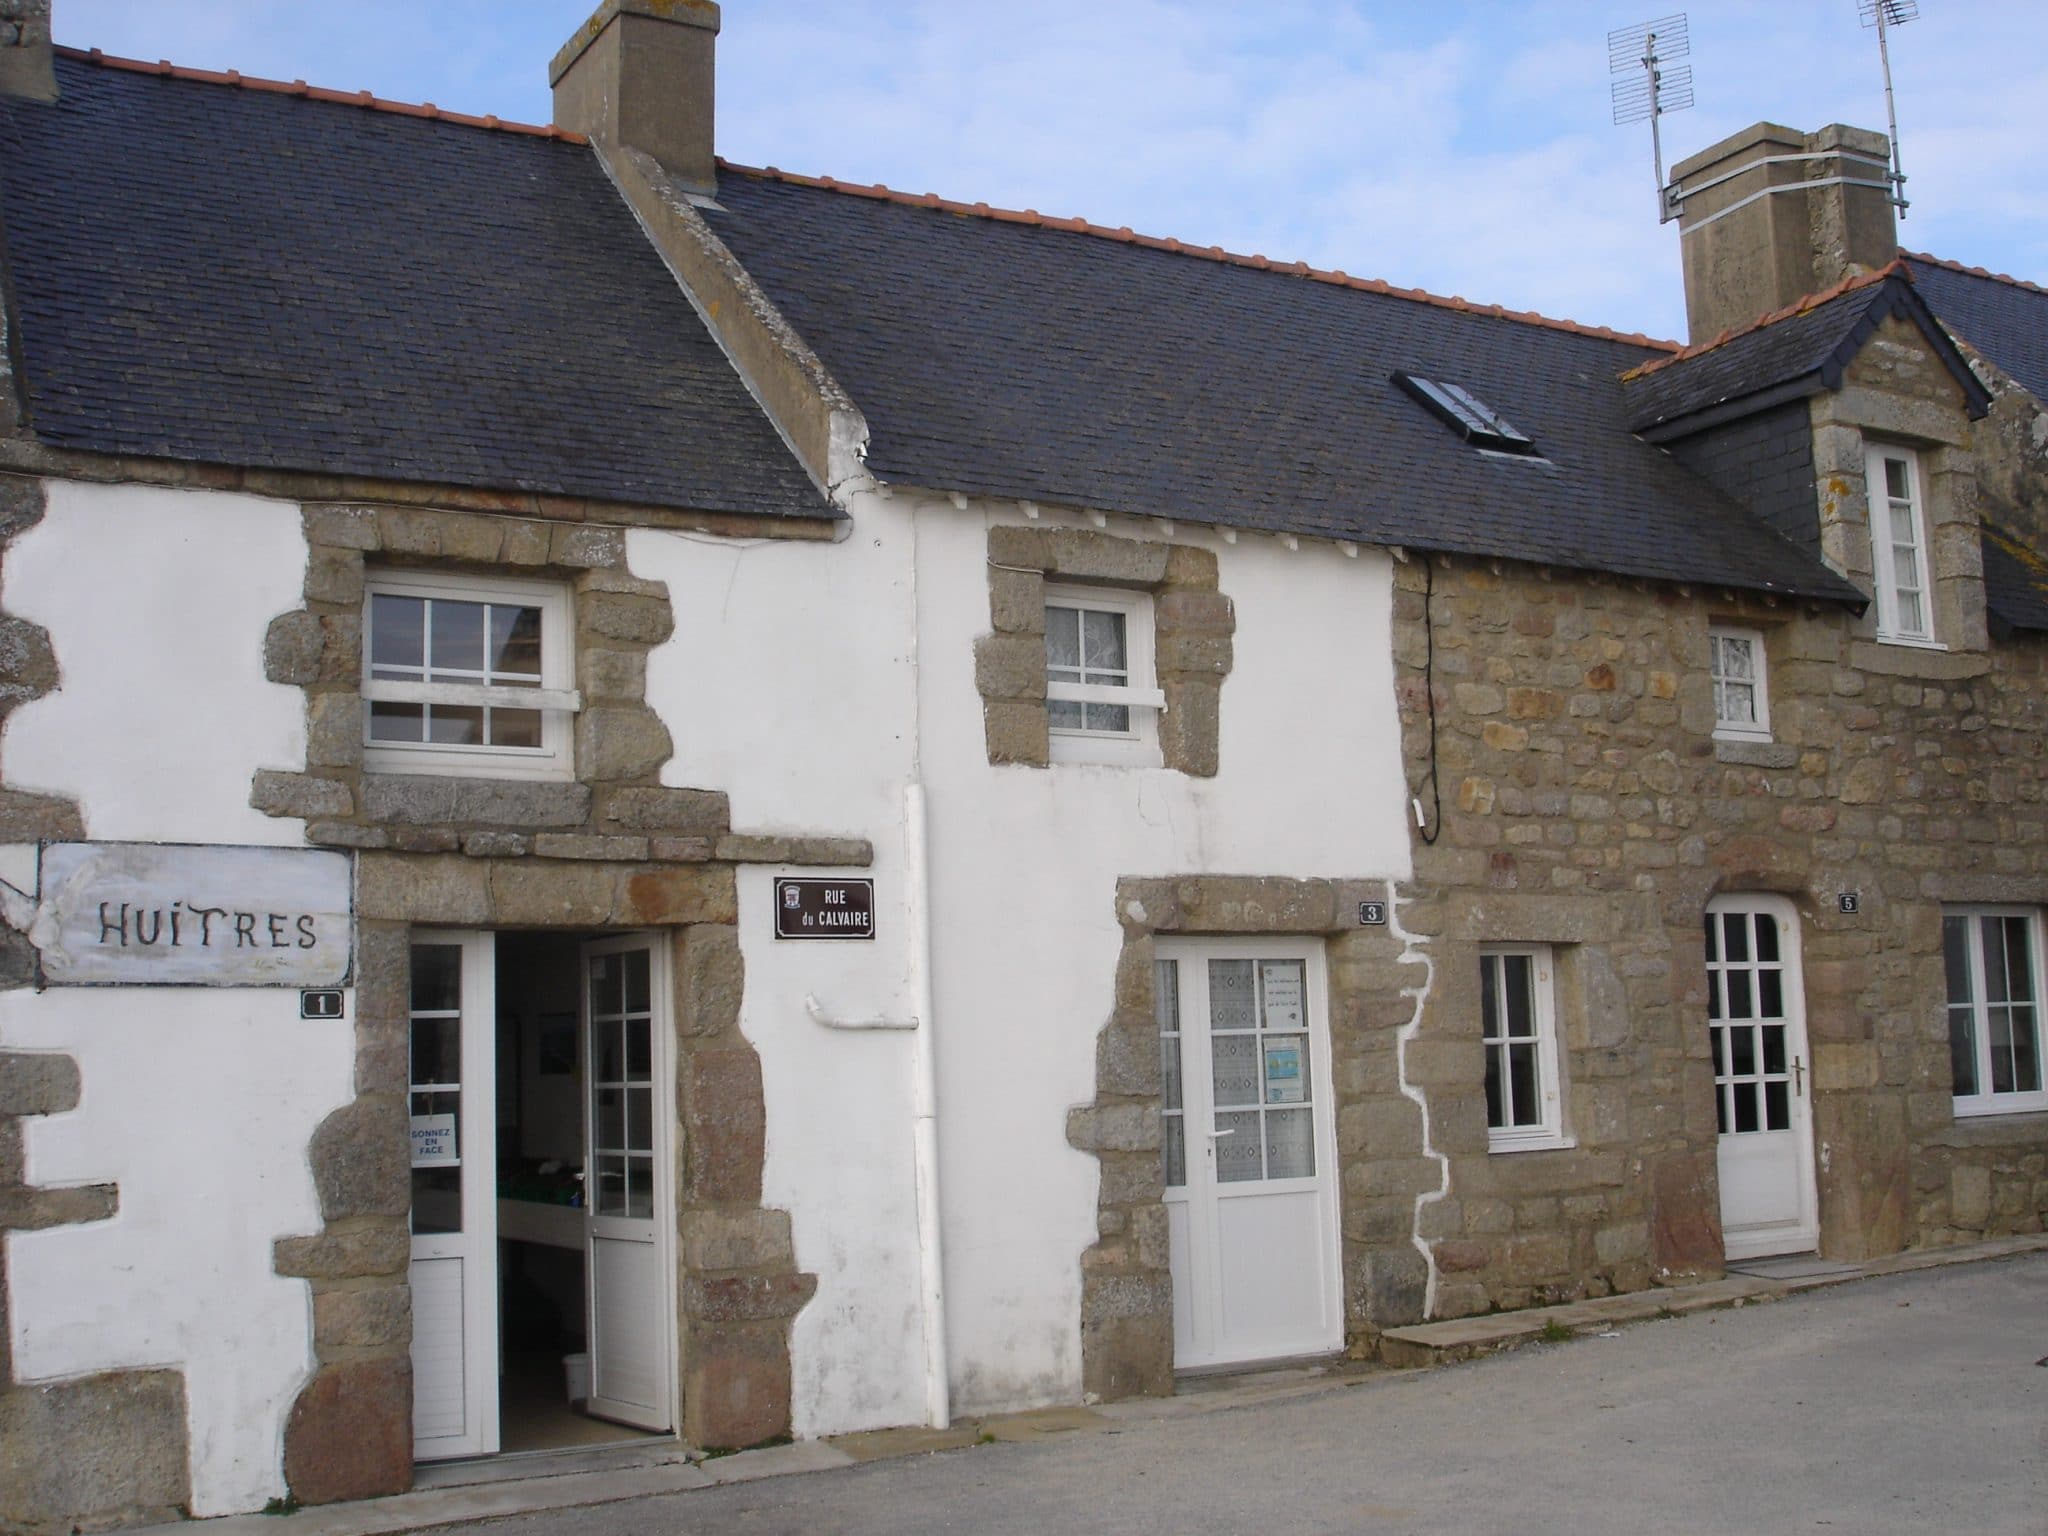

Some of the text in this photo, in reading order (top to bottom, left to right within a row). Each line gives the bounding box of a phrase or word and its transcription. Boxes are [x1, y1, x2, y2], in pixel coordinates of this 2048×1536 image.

[825, 889, 846, 904] RUE
[1845, 897, 1852, 909] 5
[802, 911, 869, 926] du CALVAIRE
[1368, 906, 1377, 921] 3
[318, 995, 327, 1014] 1
[411, 1128, 450, 1138] SONNEZ
[425, 1138, 438, 1146] EN
[419, 1146, 444, 1154] FACE
